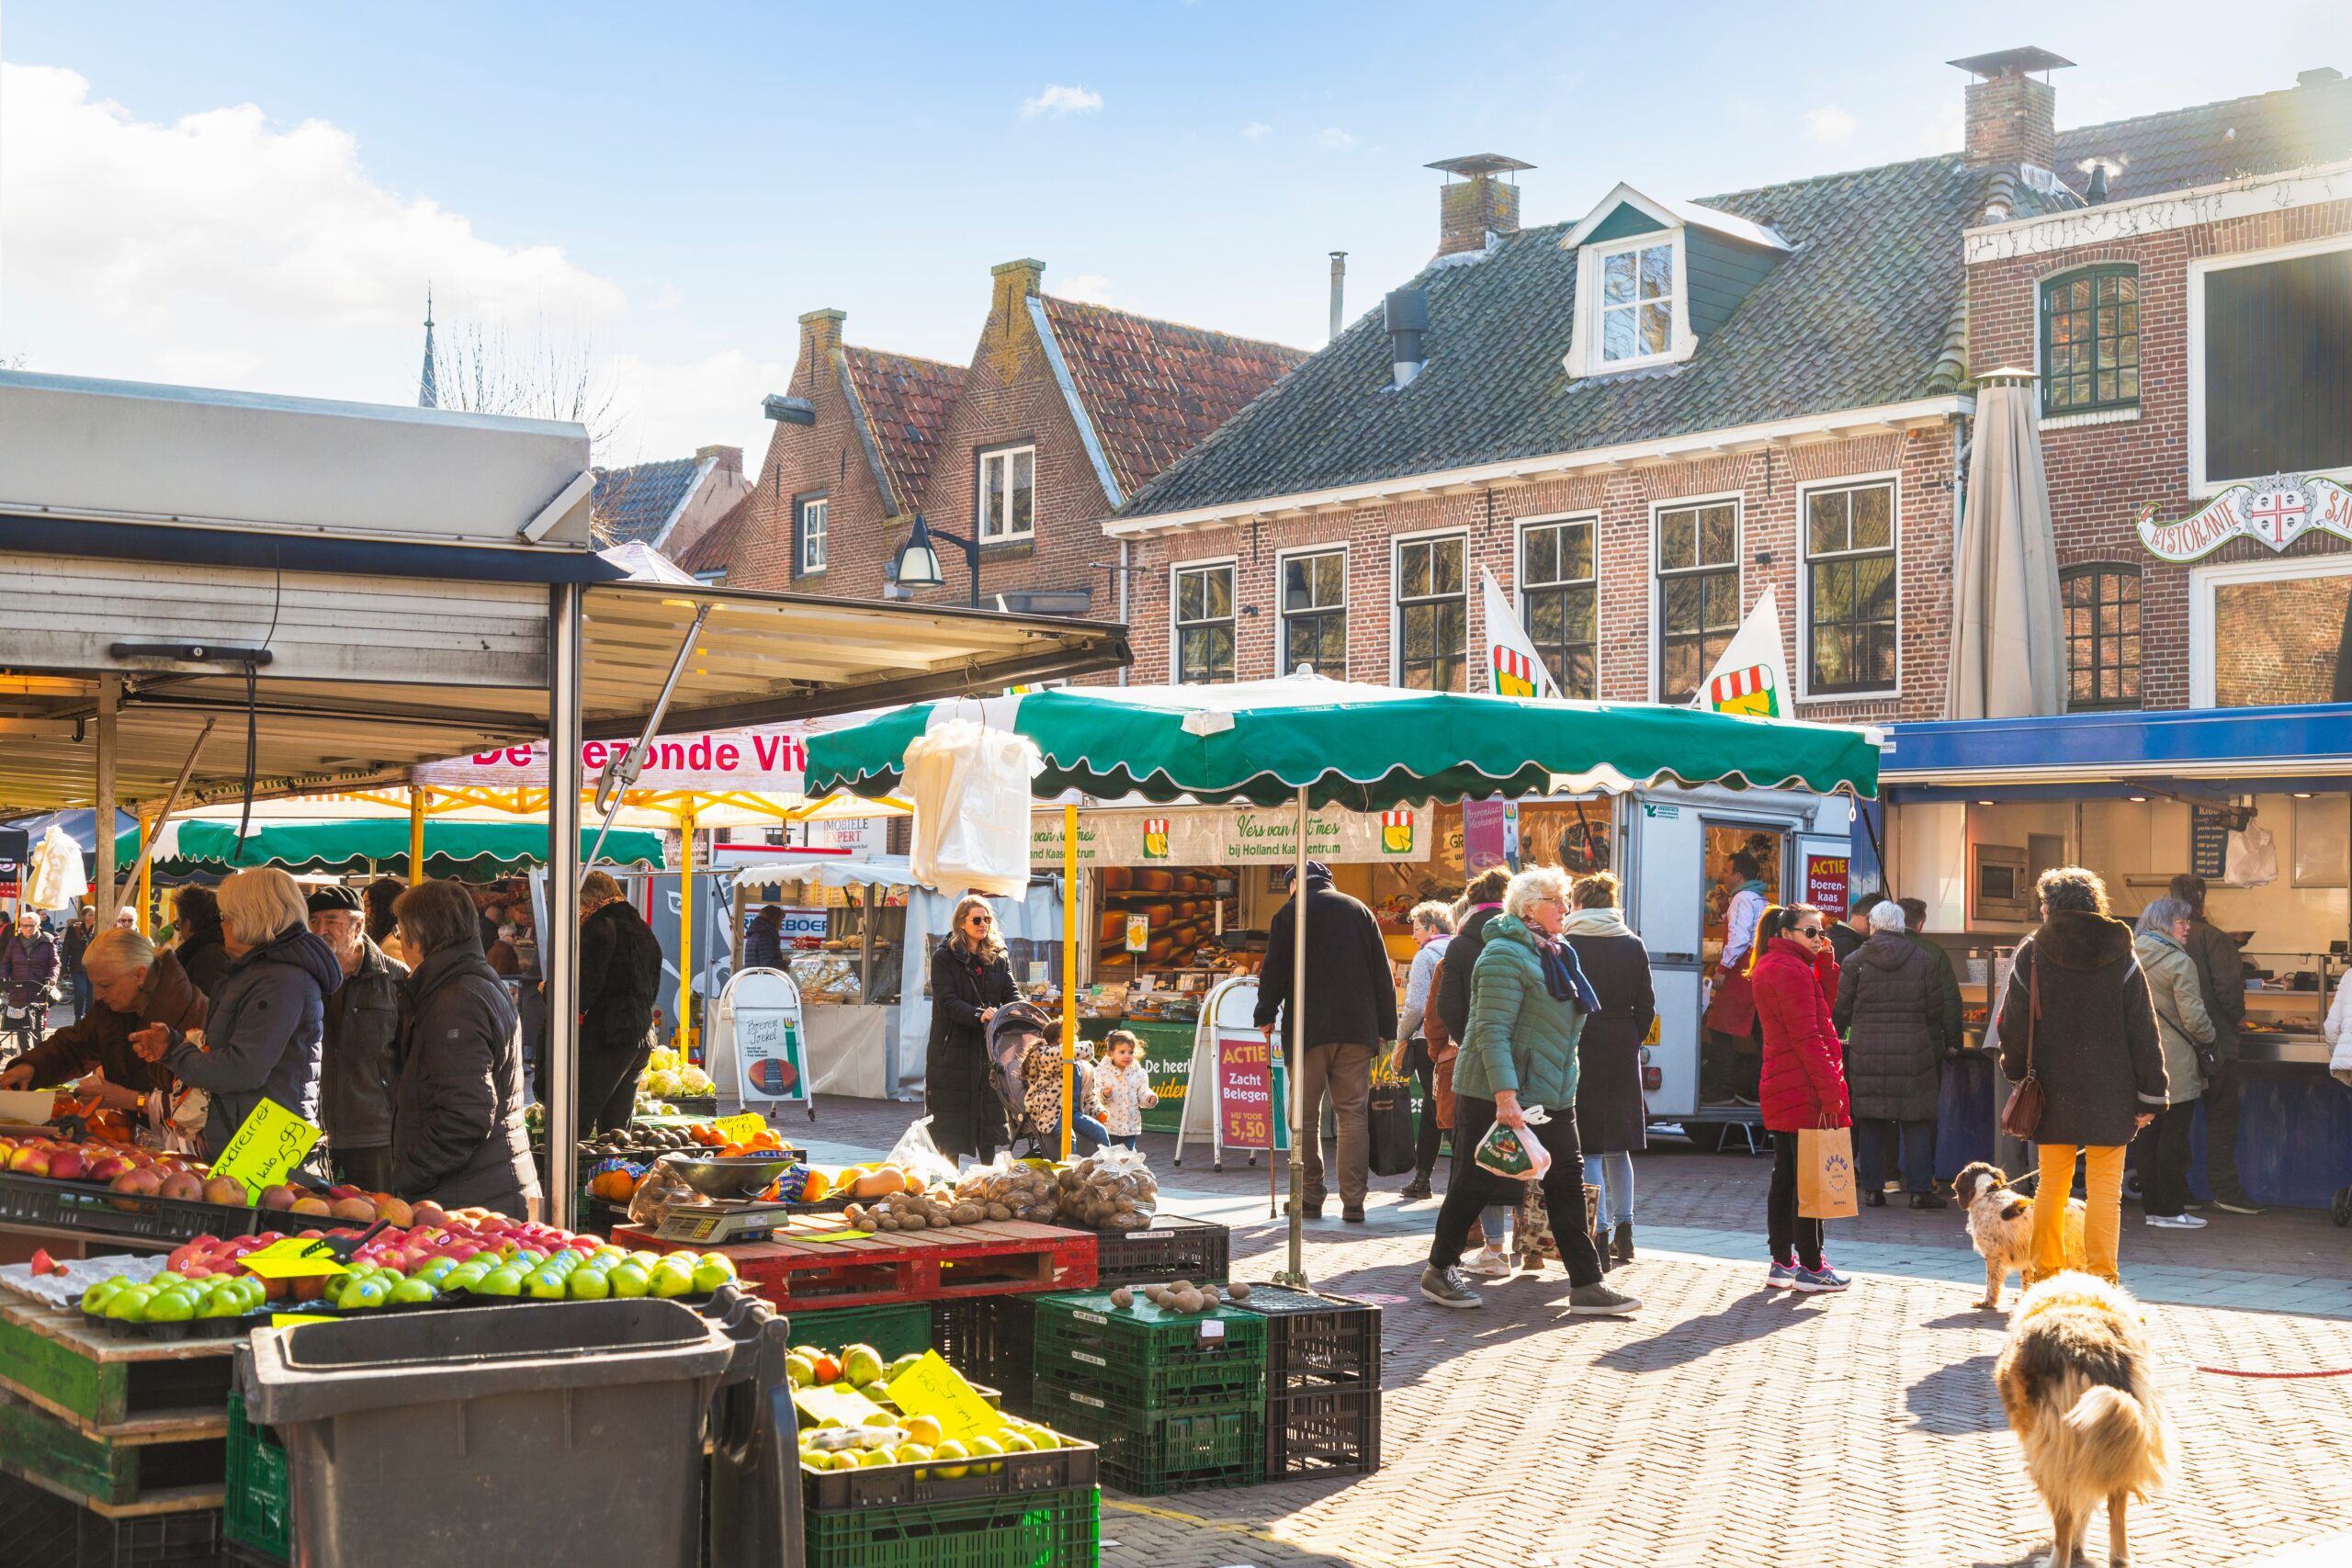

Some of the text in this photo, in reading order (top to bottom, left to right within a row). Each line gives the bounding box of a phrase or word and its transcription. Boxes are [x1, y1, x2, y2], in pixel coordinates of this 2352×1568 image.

[2150, 489, 2352, 553] RISTORANTE SA
[582, 735, 740, 772] ezonde
[1237, 814, 1265, 838] Vers
[1267, 825, 1291, 837] van
[1316, 825, 1340, 834] mes
[1228, 844, 1241, 859] bij
[1242, 842, 1280, 856] Holland
[1810, 860, 1846, 875] ACTIE
[1810, 879, 1846, 891] Boeren-
[1817, 891, 1838, 902] kaas
[1222, 1045, 1267, 1064] ACTIE
[1145, 1059, 1159, 1074] De
[1228, 1073, 1261, 1086] Zacht
[1223, 1087, 1269, 1103] Belegen
[1230, 1121, 1266, 1141] 5,50
[256, 1157, 277, 1179] kilo
